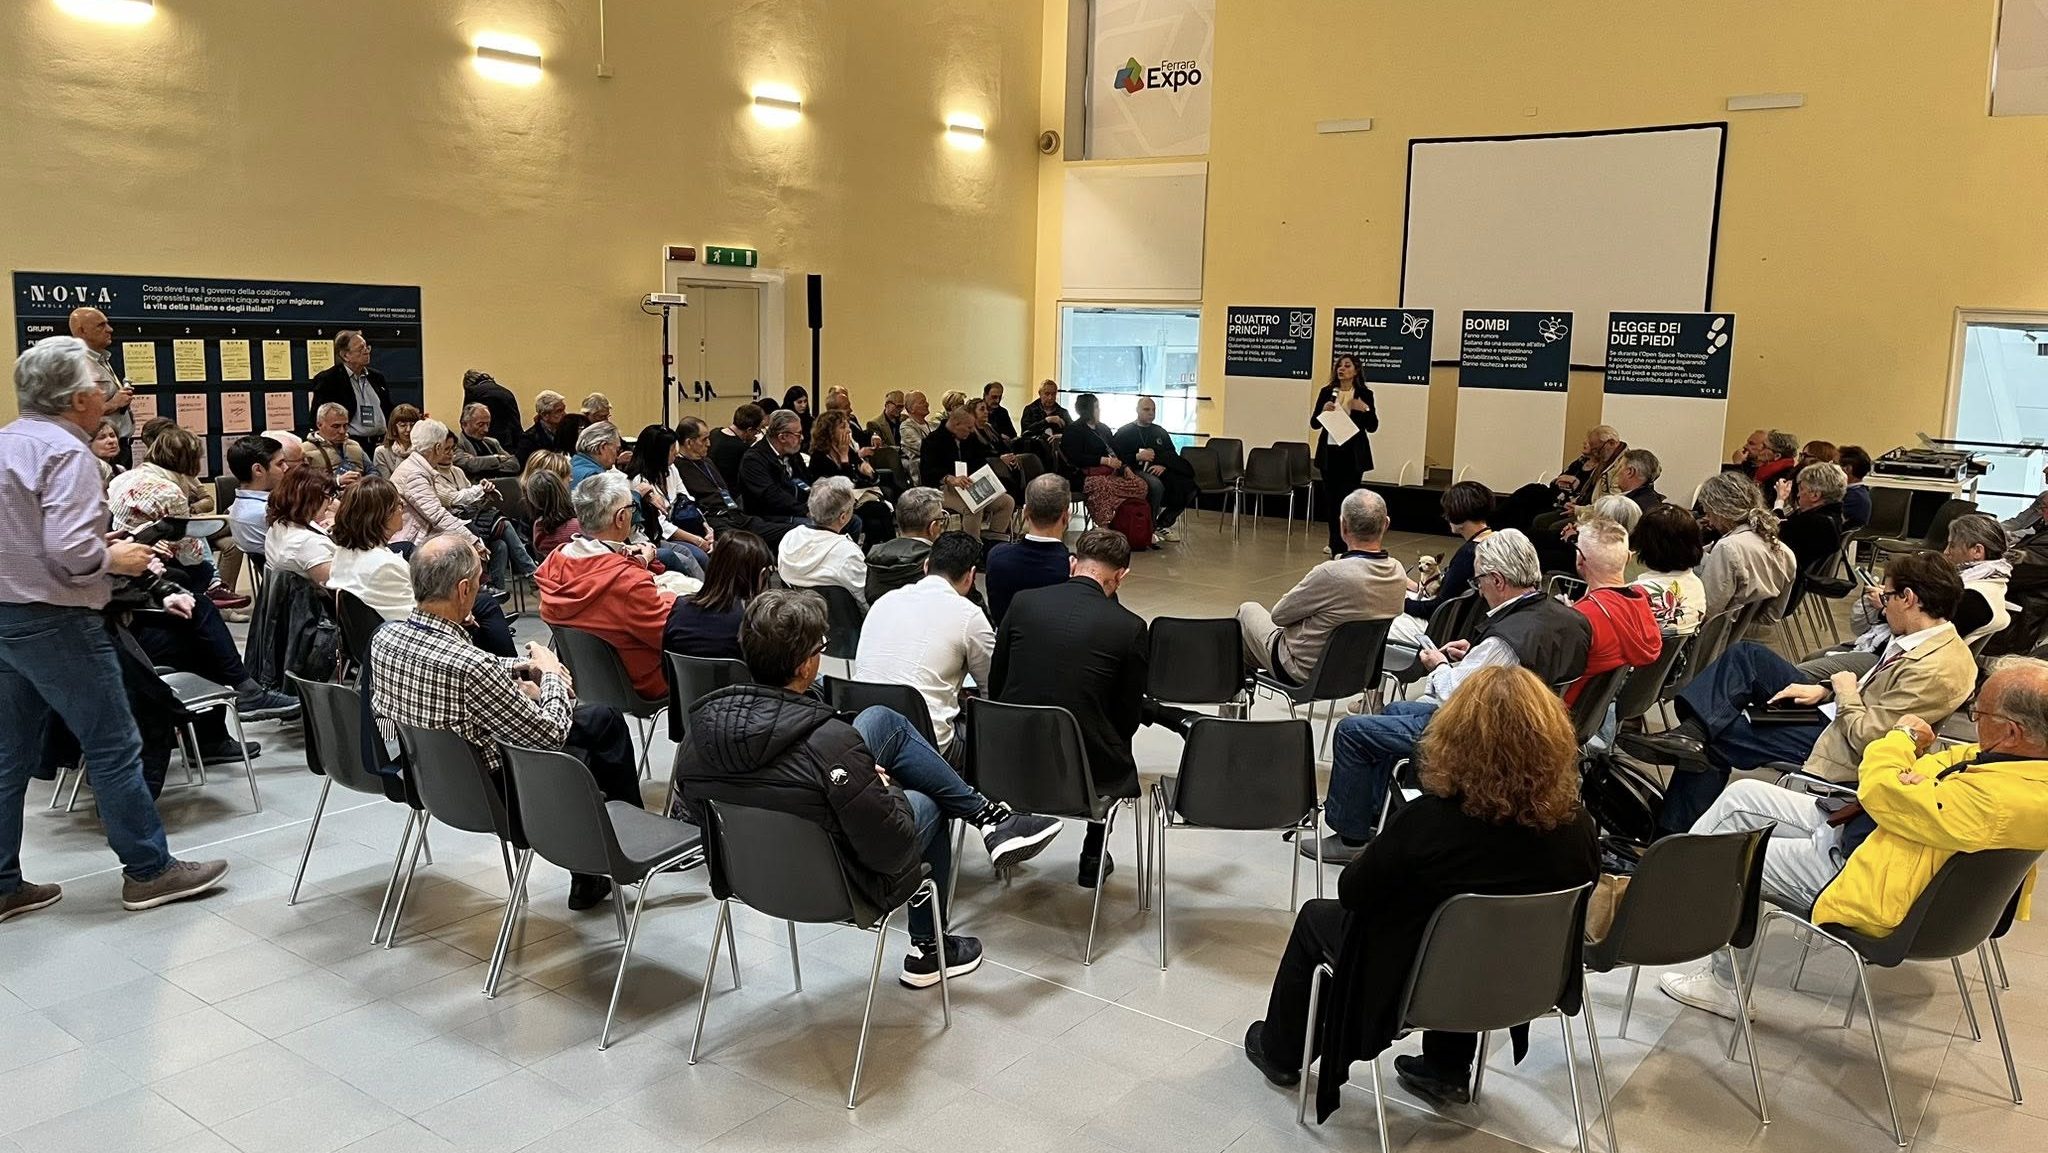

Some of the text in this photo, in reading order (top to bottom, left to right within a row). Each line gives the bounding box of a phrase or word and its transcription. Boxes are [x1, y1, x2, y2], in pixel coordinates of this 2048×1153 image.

[1162, 60, 1196, 71] Ferrara
[1147, 68, 1201, 92] Expo
[1229, 314, 1280, 324] I QUATTRO
[1336, 317, 1387, 327] FARFALLE
[1465, 319, 1509, 331] BOMBI
[1612, 321, 1681, 334] LEGGE DEI
[1610, 334, 1675, 346] DUE PIEDI
